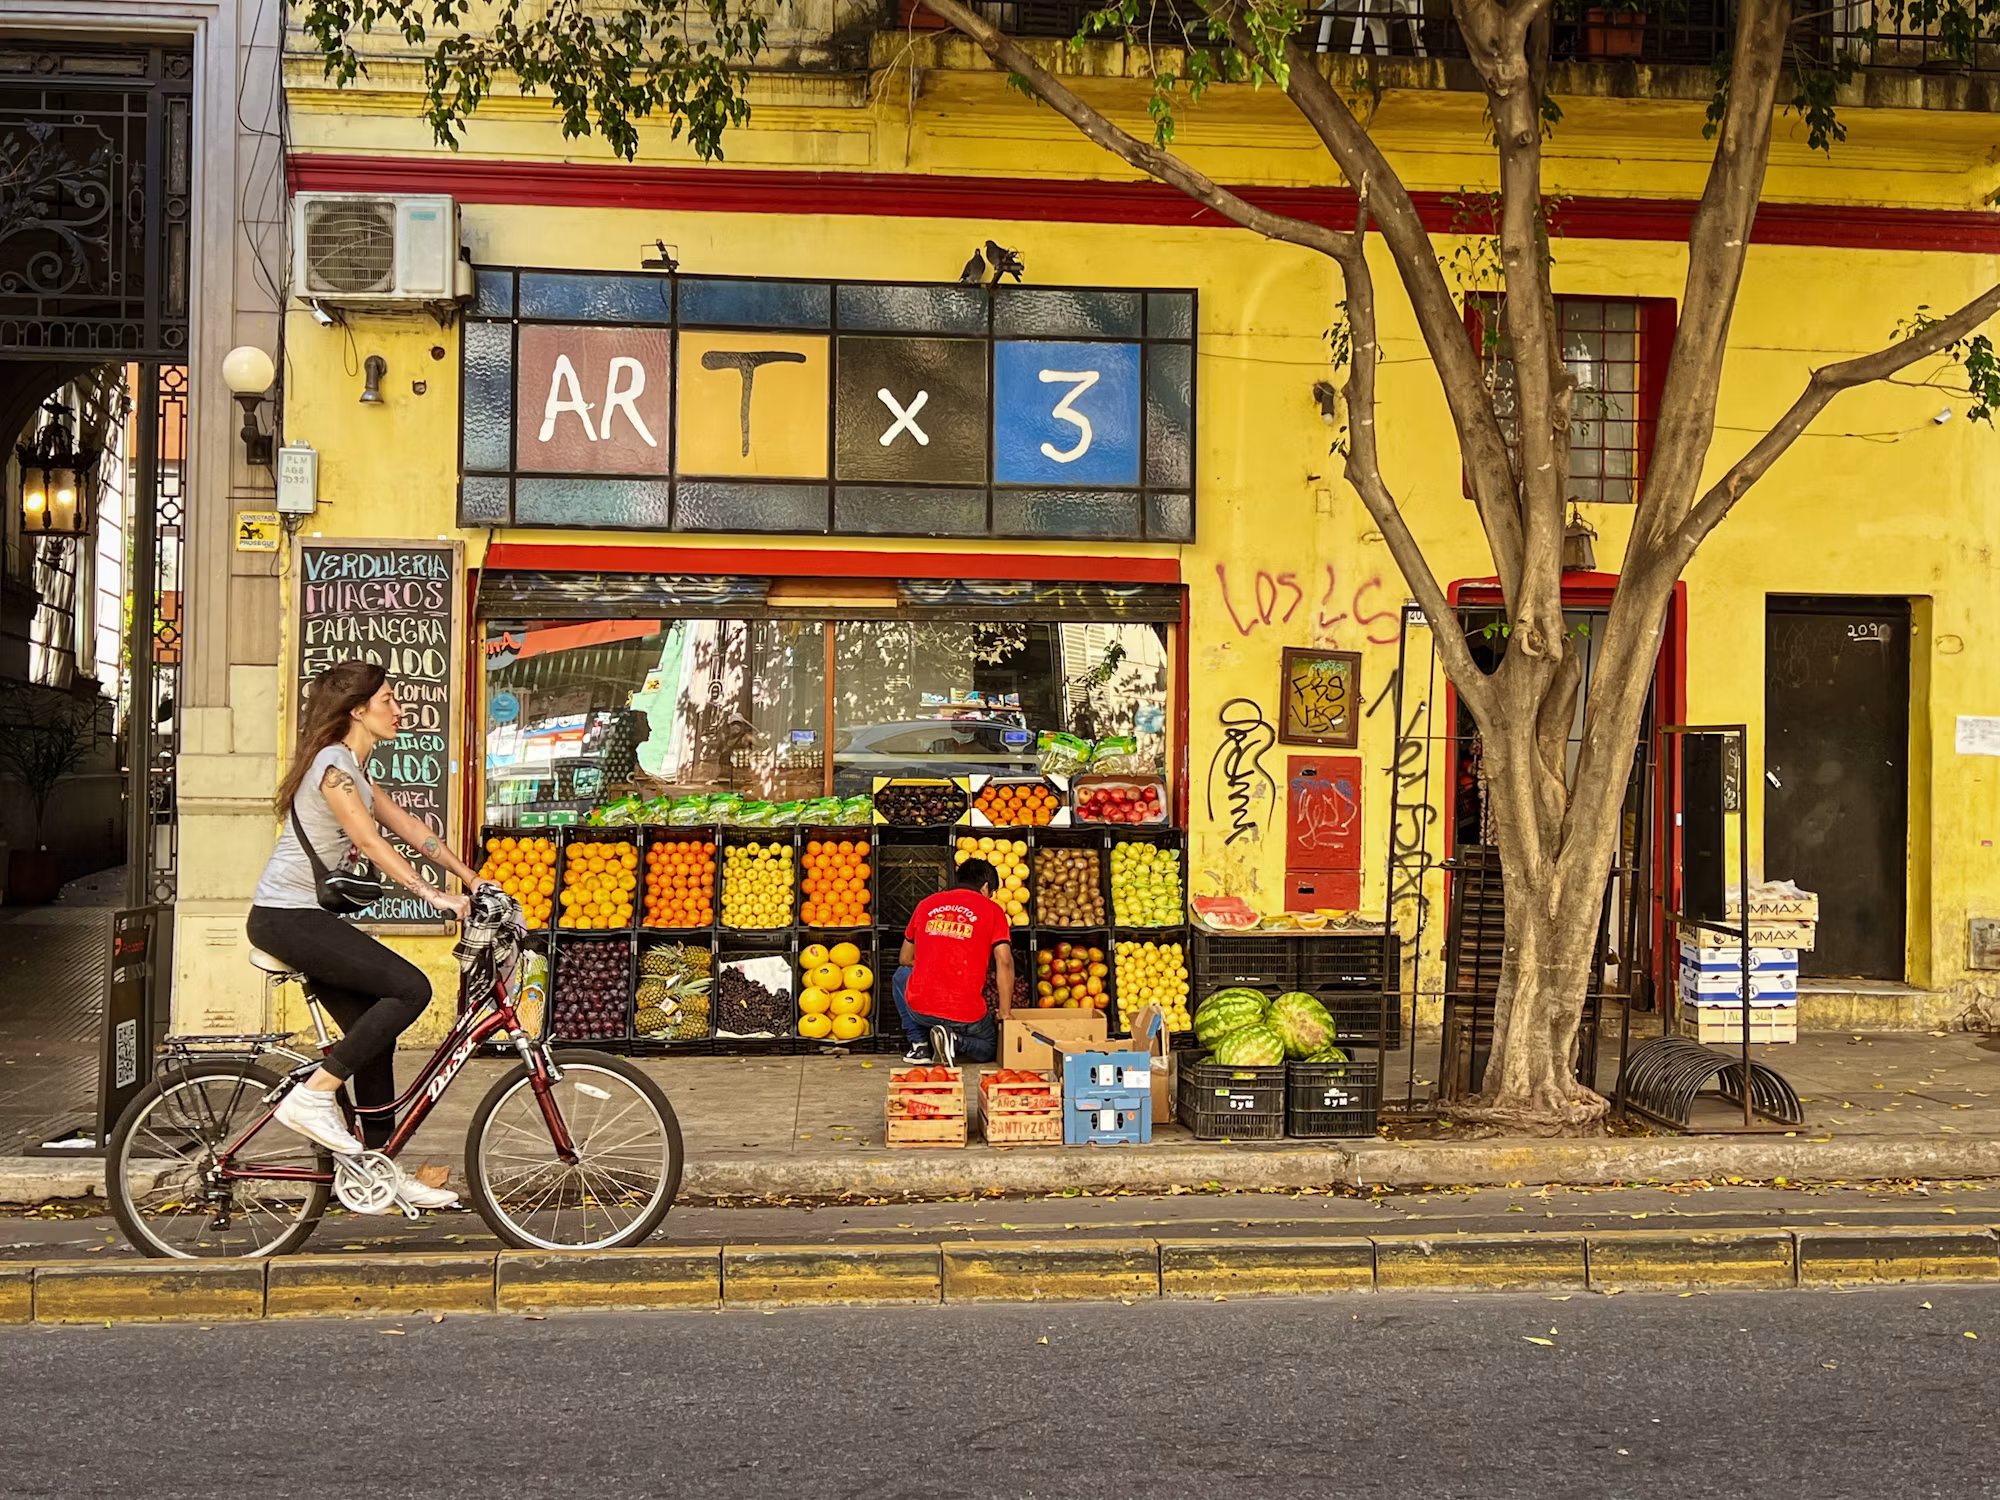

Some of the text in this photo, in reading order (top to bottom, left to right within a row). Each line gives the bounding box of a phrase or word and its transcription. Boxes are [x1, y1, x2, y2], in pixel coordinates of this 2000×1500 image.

[1039, 369, 1101, 464] 3
[304, 551, 450, 580] VERDULERIA
[306, 582, 444, 613] MILAGROS
[306, 617, 447, 645] PAPA-NEGRA
[391, 754, 442, 784] 100
[927, 904, 978, 922] PRODUCTOS
